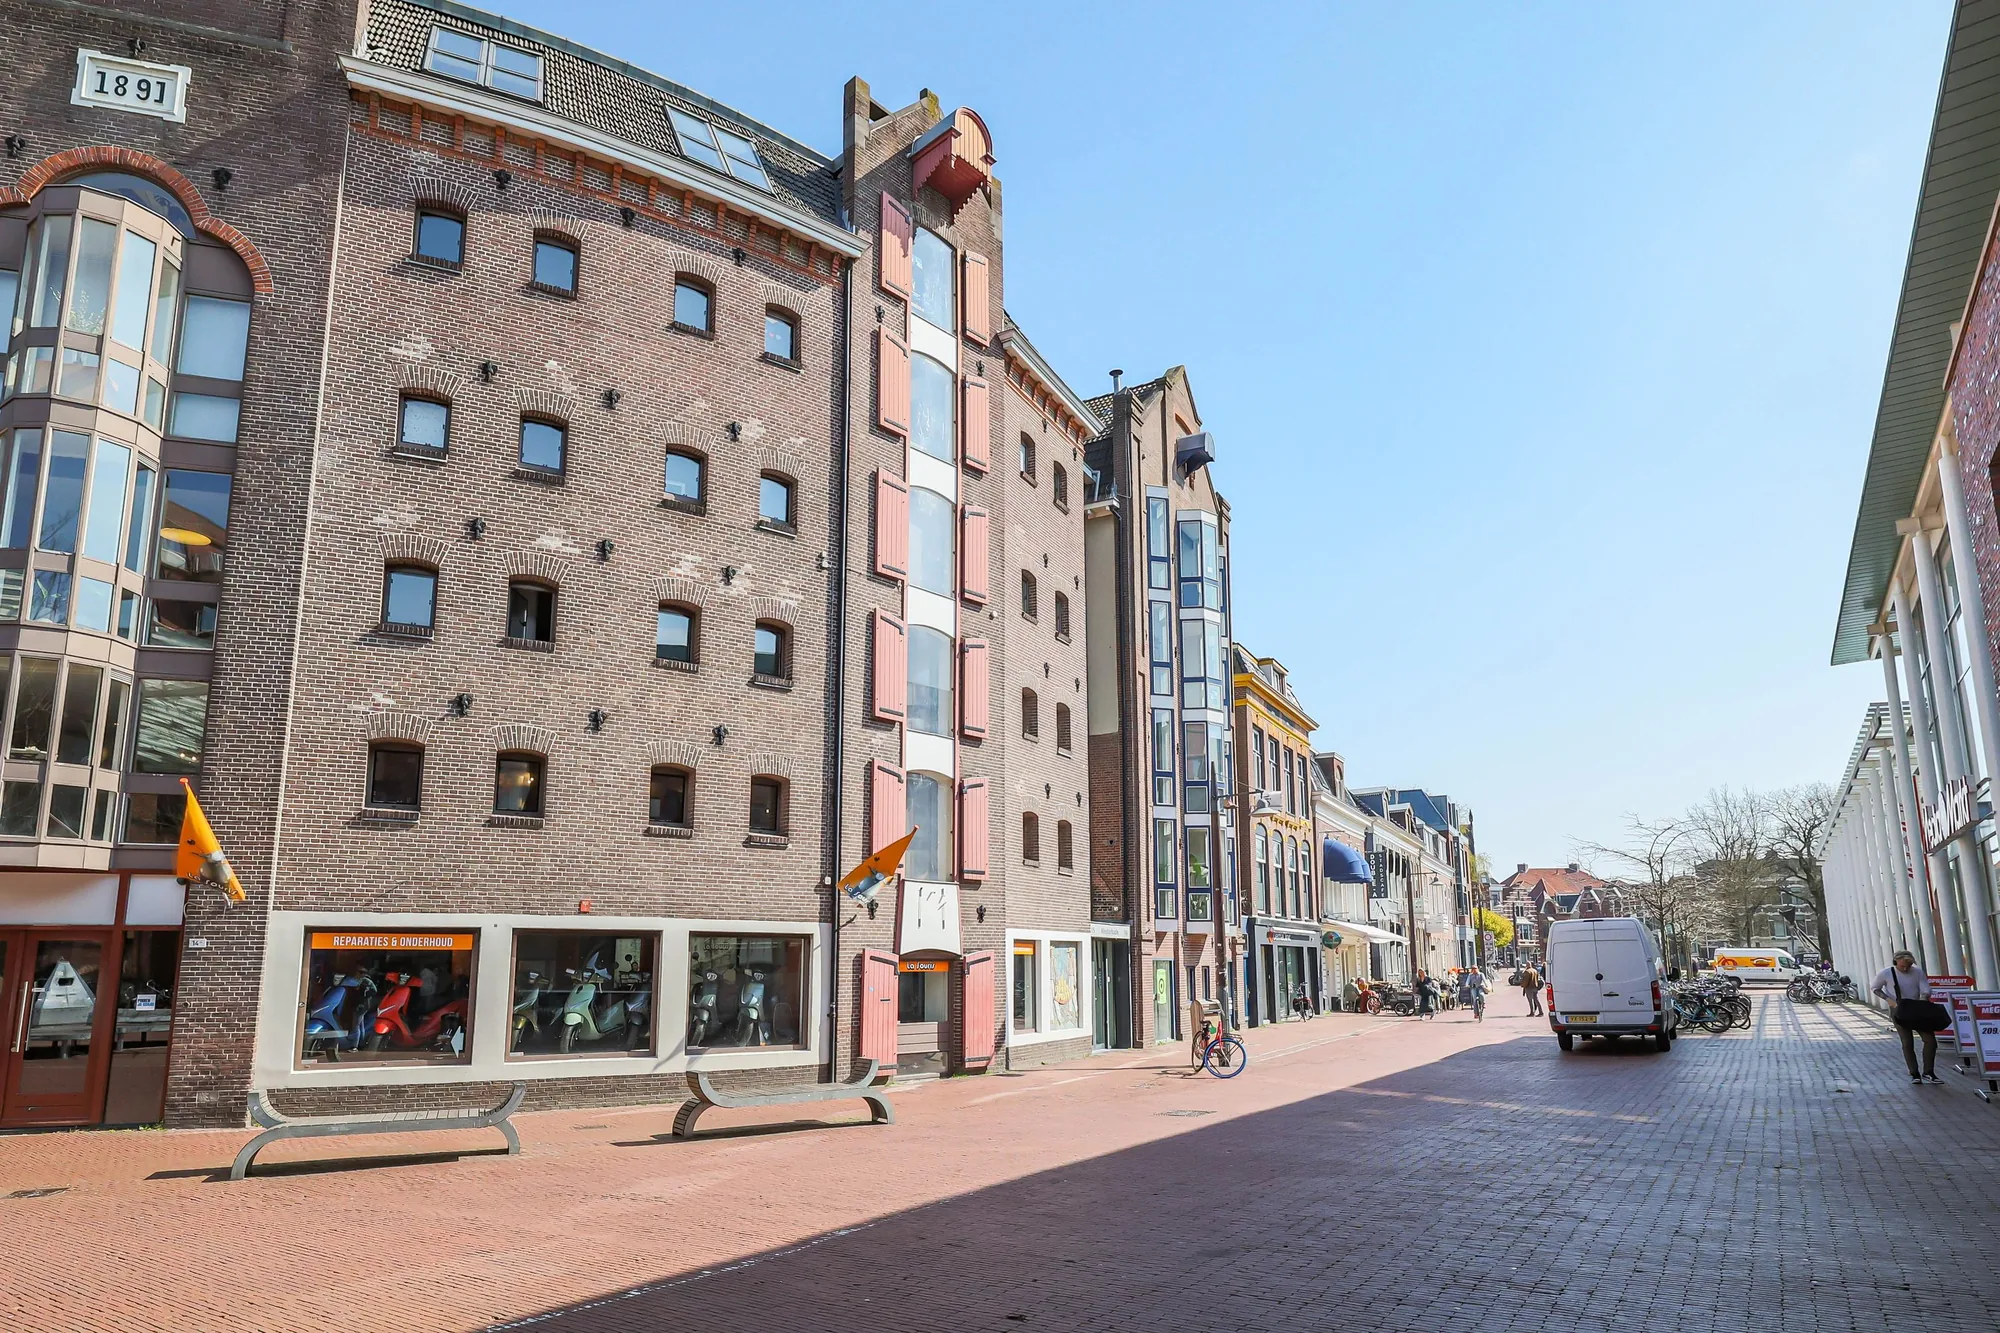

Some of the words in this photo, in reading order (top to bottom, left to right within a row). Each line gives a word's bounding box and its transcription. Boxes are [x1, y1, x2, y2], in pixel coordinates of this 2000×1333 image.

[94, 70, 166, 104] 1891
[333, 936, 389, 947] REPARATIES
[391, 937, 398, 947] &
[399, 937, 453, 947] ONDERHOUD
